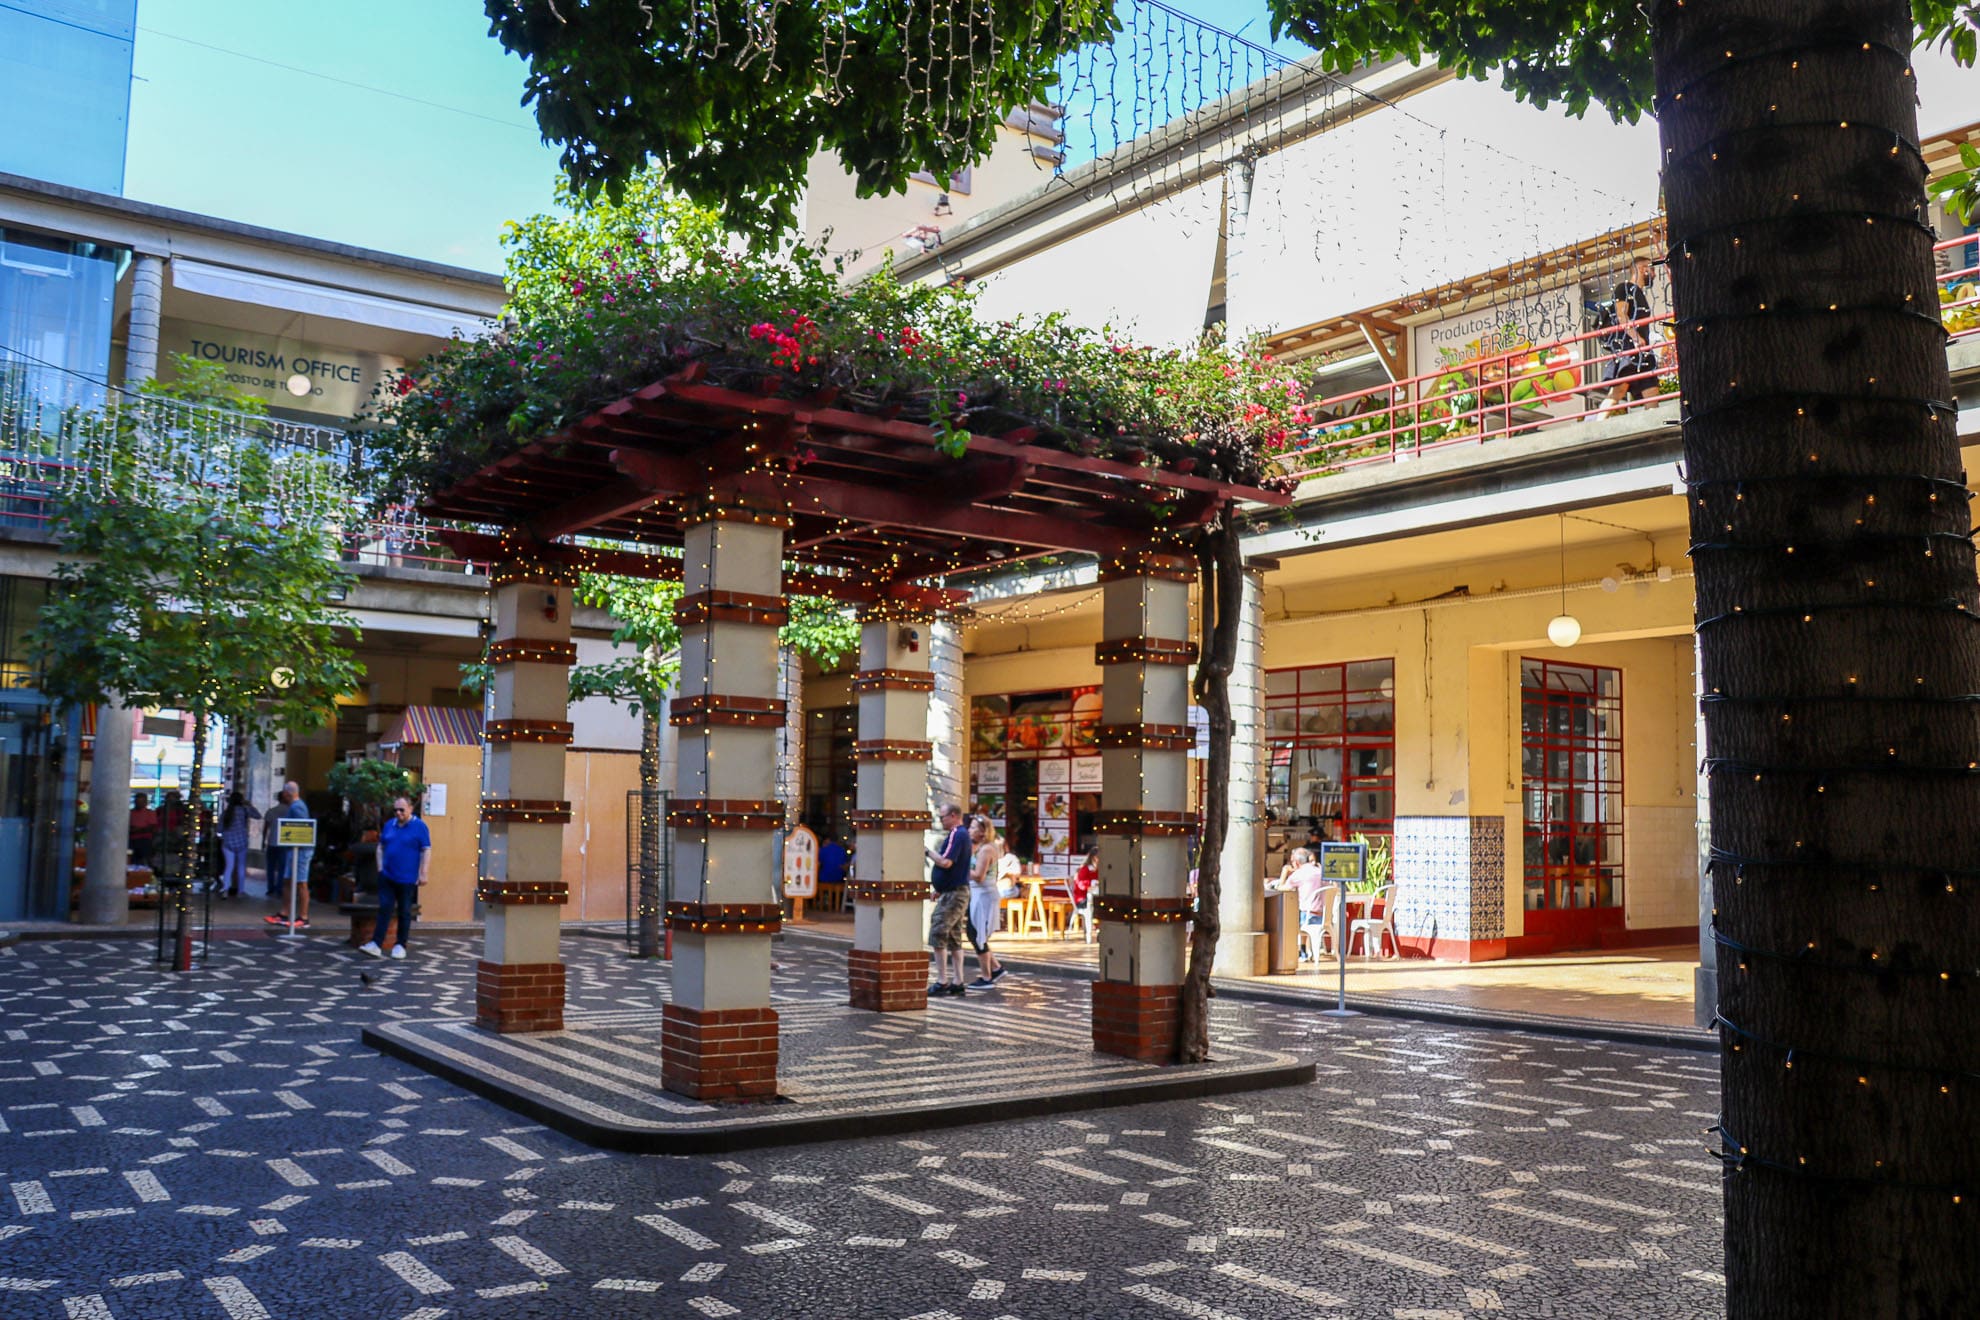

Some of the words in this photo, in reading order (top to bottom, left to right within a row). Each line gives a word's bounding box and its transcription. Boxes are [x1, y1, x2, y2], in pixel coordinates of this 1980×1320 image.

[1431, 316, 1493, 344] Produtos
[191, 340, 285, 371] TOURISM
[292, 357, 361, 383] OFFICE
[1434, 346, 1477, 368] sempre
[263, 378, 276, 389] DE
